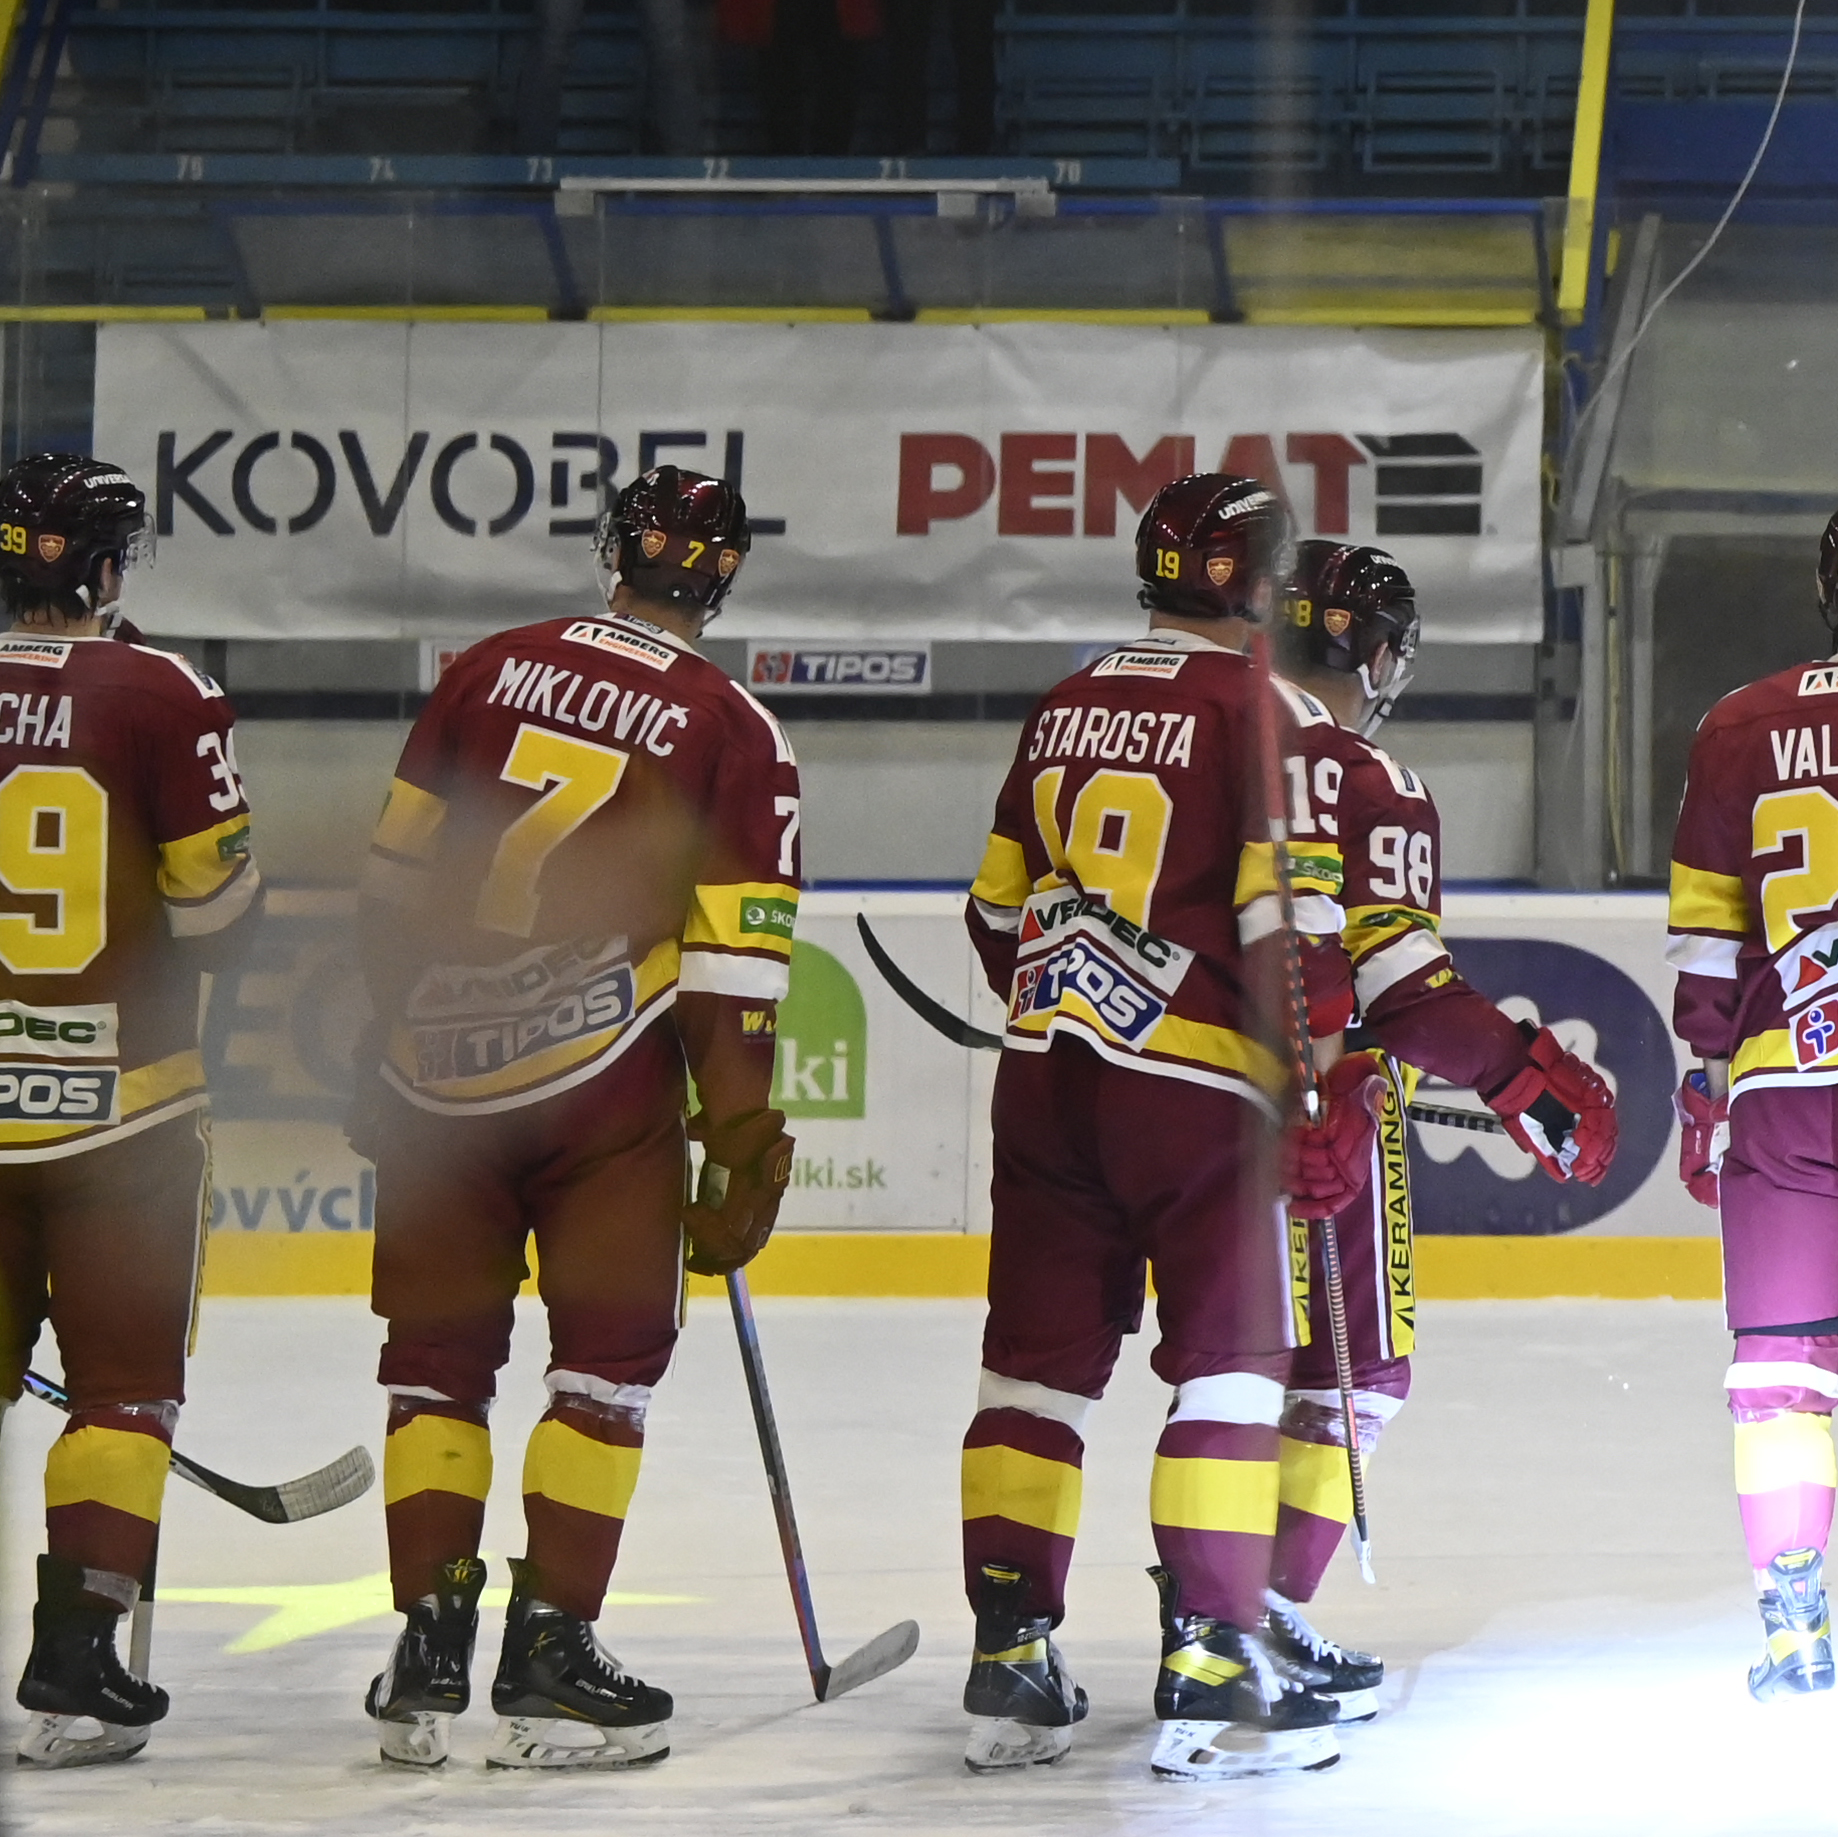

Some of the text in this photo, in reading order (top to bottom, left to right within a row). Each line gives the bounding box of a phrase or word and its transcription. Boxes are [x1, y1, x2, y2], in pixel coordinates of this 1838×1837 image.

[896, 431, 1367, 536] PEMAT
[0, 523, 28, 554] 39
[681, 540, 706, 570] 7
[1155, 547, 1181, 581] 19
[603, 629, 670, 661] AMBERG
[800, 651, 928, 685] TIPOS
[1125, 654, 1181, 667] AMBERG
[486, 656, 691, 758] MIKLOVIČ
[1028, 706, 1197, 769] STAROSTA
[474, 721, 630, 939] 7
[773, 795, 800, 877] 7
[1285, 755, 1344, 836] 19
[1032, 764, 1174, 931] 19
[1367, 825, 1433, 911] 98
[465, 977, 623, 1068] TIPOS
[1381, 1090, 1411, 1297] KERAMING
